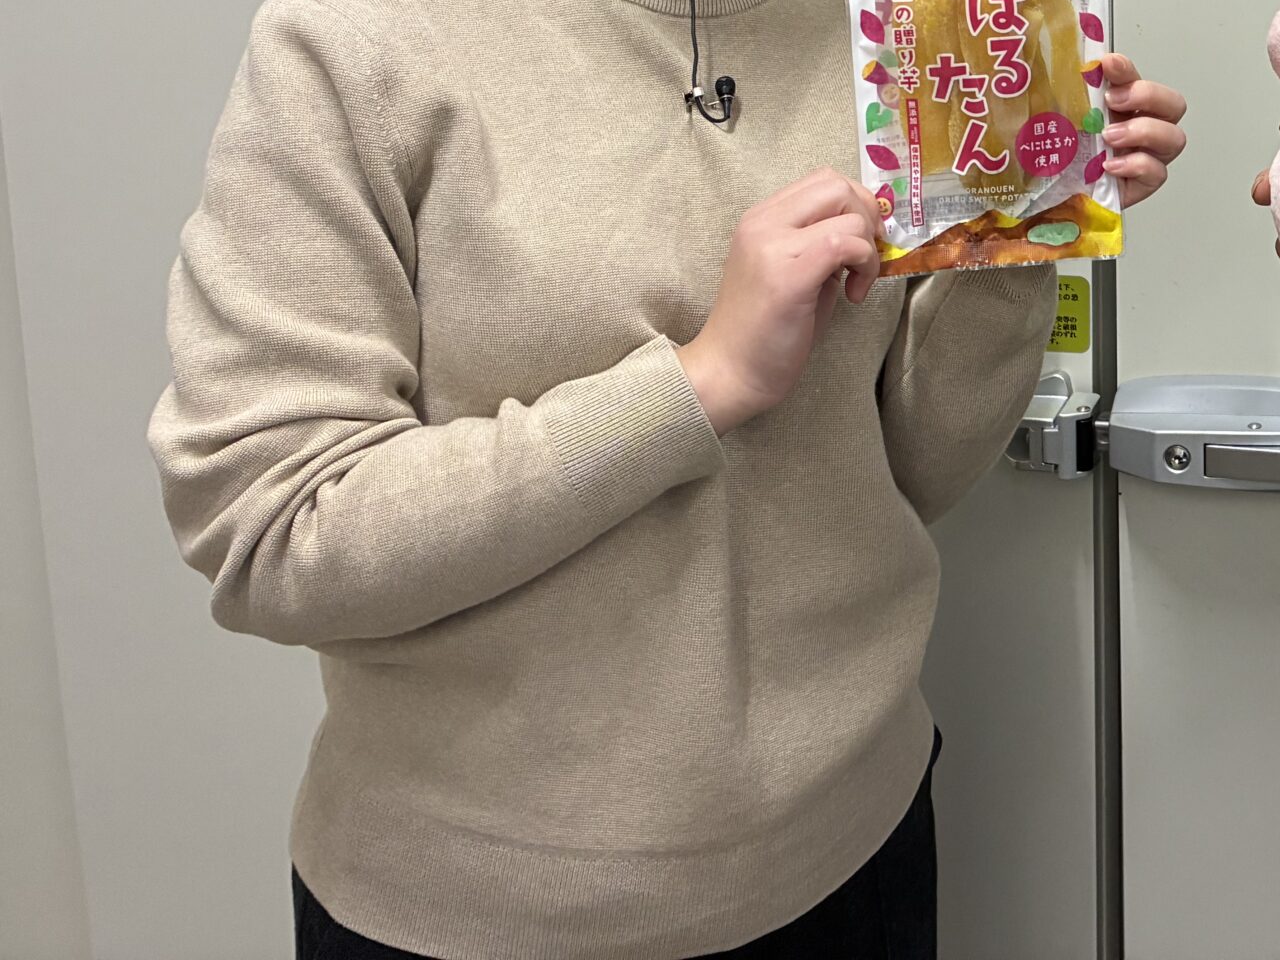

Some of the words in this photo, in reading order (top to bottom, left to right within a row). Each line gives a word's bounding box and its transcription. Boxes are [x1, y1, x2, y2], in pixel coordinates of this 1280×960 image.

[1033, 120, 1058, 136] 国産
[1020, 136, 1076, 151] べにはるか
[1034, 153, 1060, 168] 使用
[961, 184, 1015, 194] ORANOUEN
